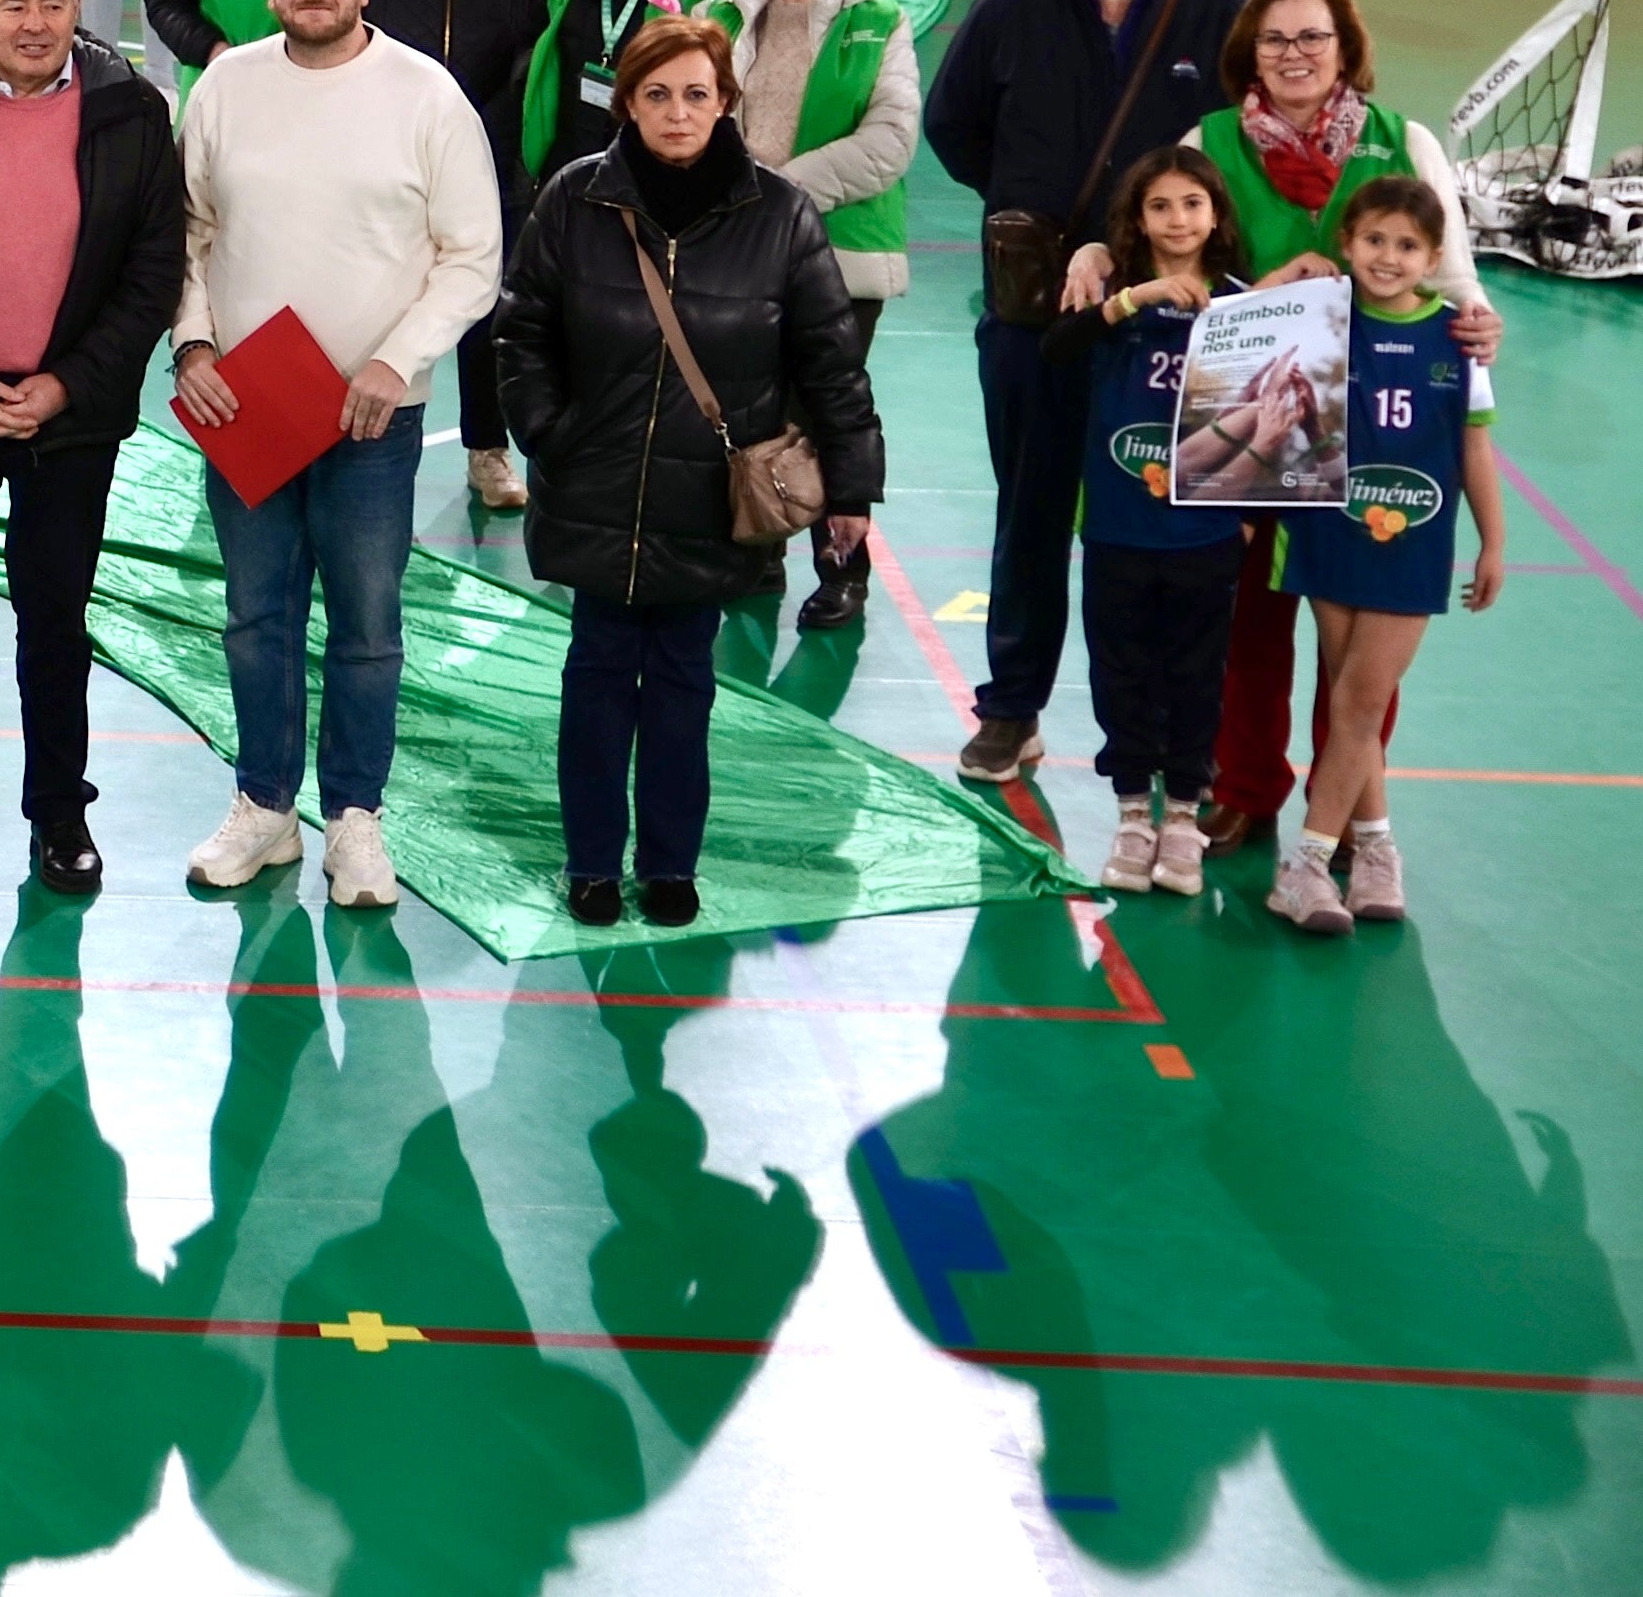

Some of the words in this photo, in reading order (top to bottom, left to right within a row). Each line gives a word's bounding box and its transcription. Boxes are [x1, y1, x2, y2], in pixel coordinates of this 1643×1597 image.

[1207, 313, 1224, 329] El
[1228, 302, 1305, 325] símbolo
[1201, 339, 1234, 355] nos
[1239, 334, 1277, 349] une
[1204, 325, 1240, 344] que
[1148, 351, 1186, 392] 23
[1374, 387, 1413, 429] 15
